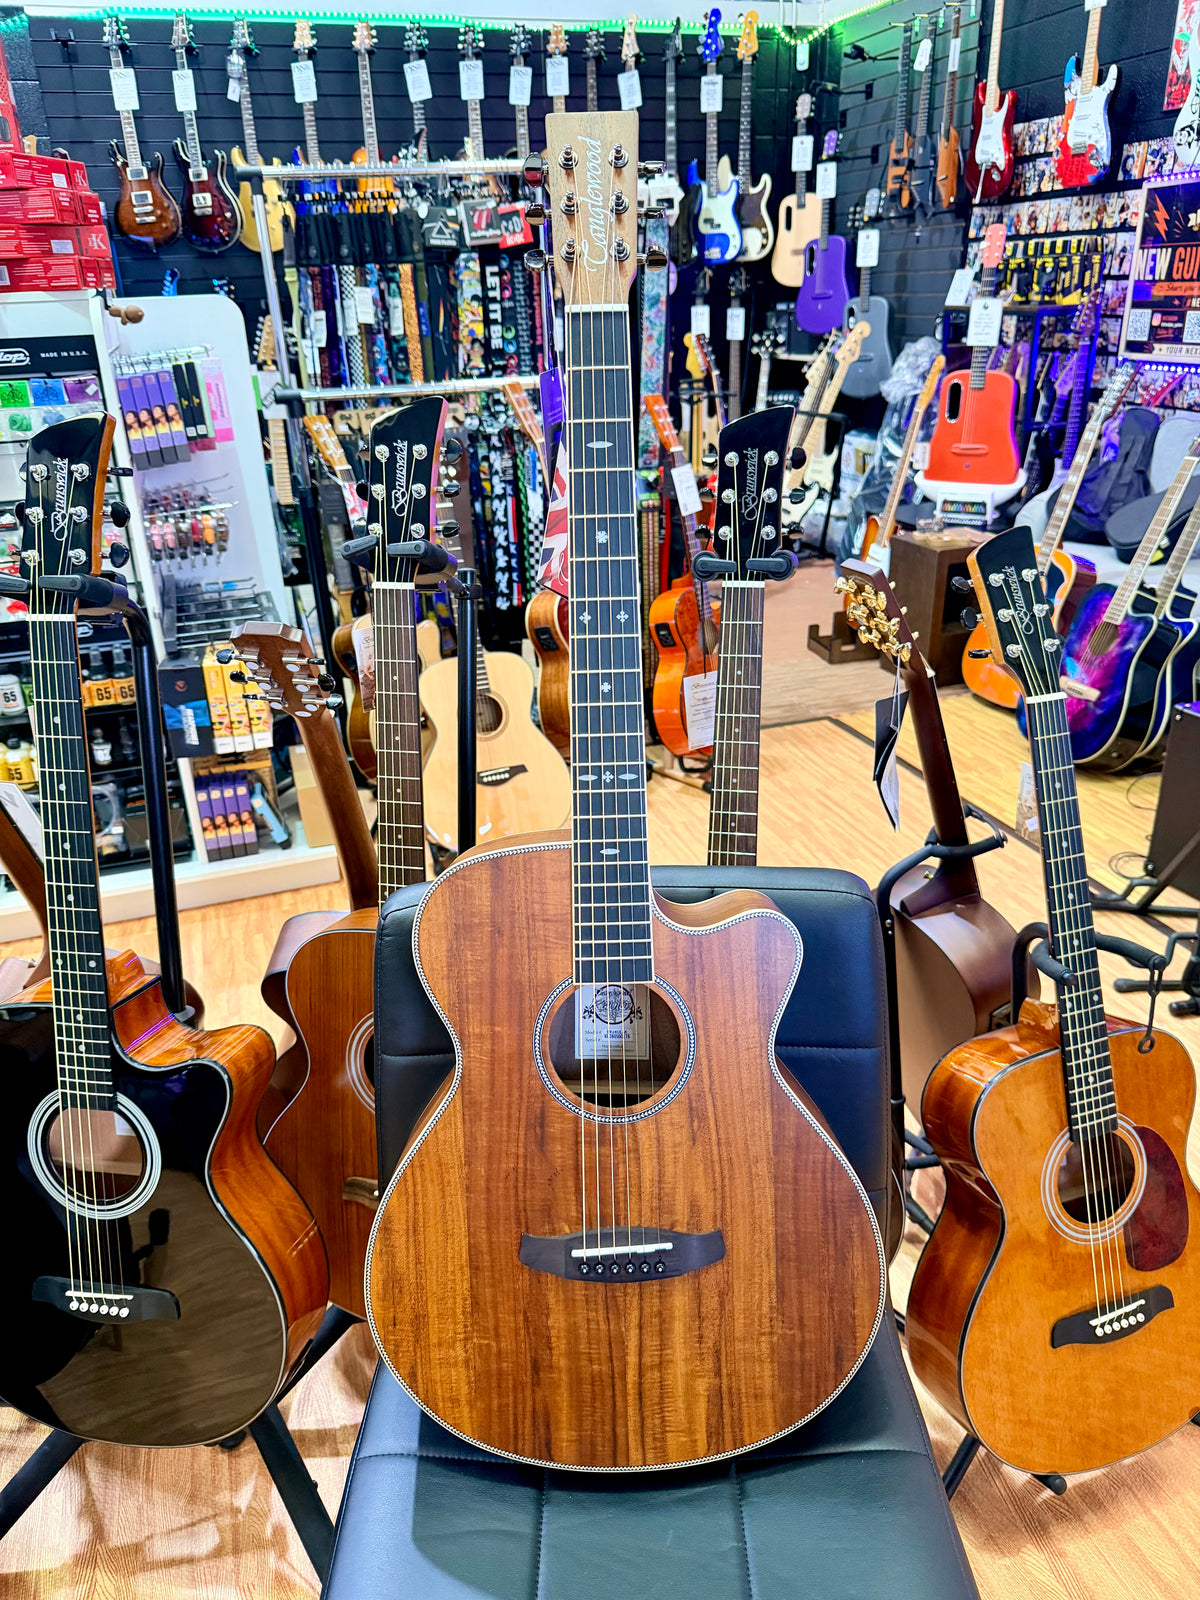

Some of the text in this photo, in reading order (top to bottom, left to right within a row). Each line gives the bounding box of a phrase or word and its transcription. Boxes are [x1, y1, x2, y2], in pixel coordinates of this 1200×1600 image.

[577, 136, 616, 272] Tanglewood
[1134, 247, 1172, 281] NEW
[485, 265, 504, 350] LET IT BE
[50, 457, 69, 541] Brunswick
[391, 439, 408, 517] Brunswick
[741, 447, 759, 521] Brunswick
[1001, 565, 1034, 635] Brunswick
[3, 691, 17, 703] 65
[96, 687, 112, 701] 65
[120, 684, 135, 699] 65
